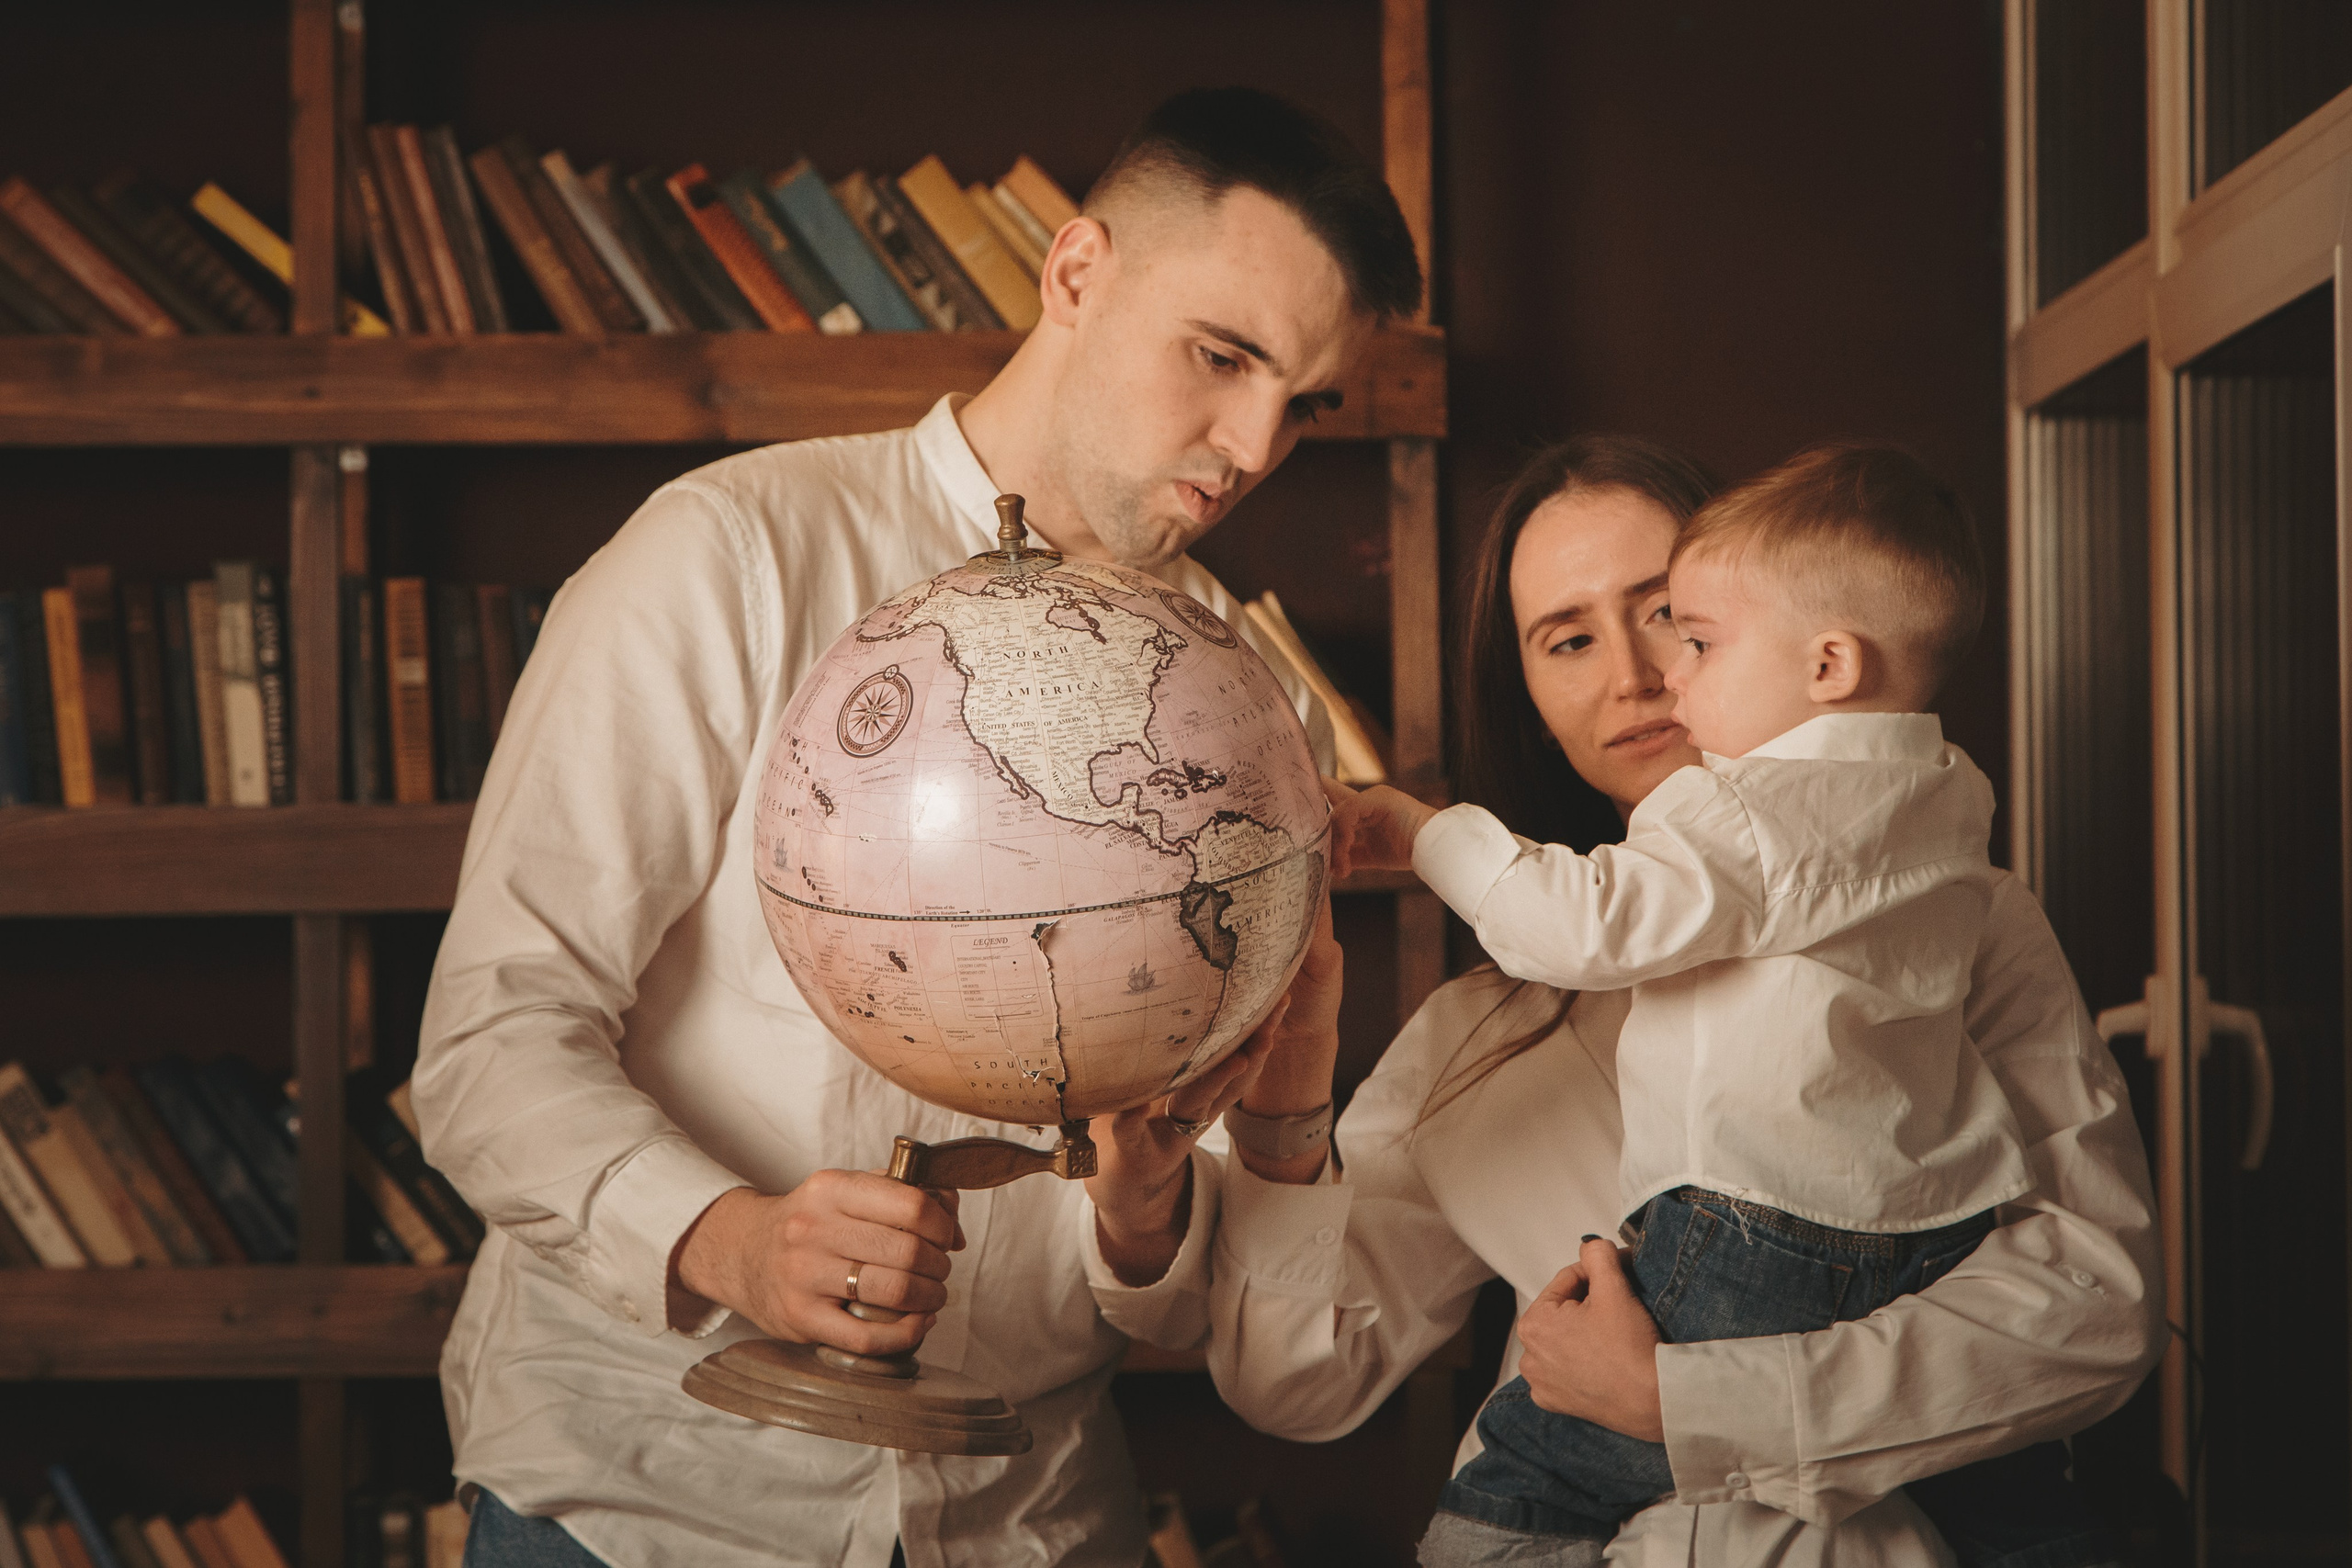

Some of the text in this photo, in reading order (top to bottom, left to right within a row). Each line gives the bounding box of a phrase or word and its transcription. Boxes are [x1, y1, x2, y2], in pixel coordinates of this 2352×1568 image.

[1003, 646, 1069, 660] NORTH
[1005, 681, 1099, 698] AMERICA
[1057, 716, 1088, 725] AMERICA
[1109, 769, 1136, 778] MEXICO
[1052, 771, 1074, 800] MEXICO
[1220, 829, 1256, 846] VENEZUELA
[1244, 864, 1284, 888] SOUTH
[1103, 912, 1136, 922] GALAPAGOS
[1235, 897, 1292, 930] AMERICA
[973, 937, 1009, 947] LEGEND
[874, 965, 895, 974] FRENCH
[882, 974, 918, 986] ARCHIPELAGO
[974, 1058, 1047, 1070] SOUTH
